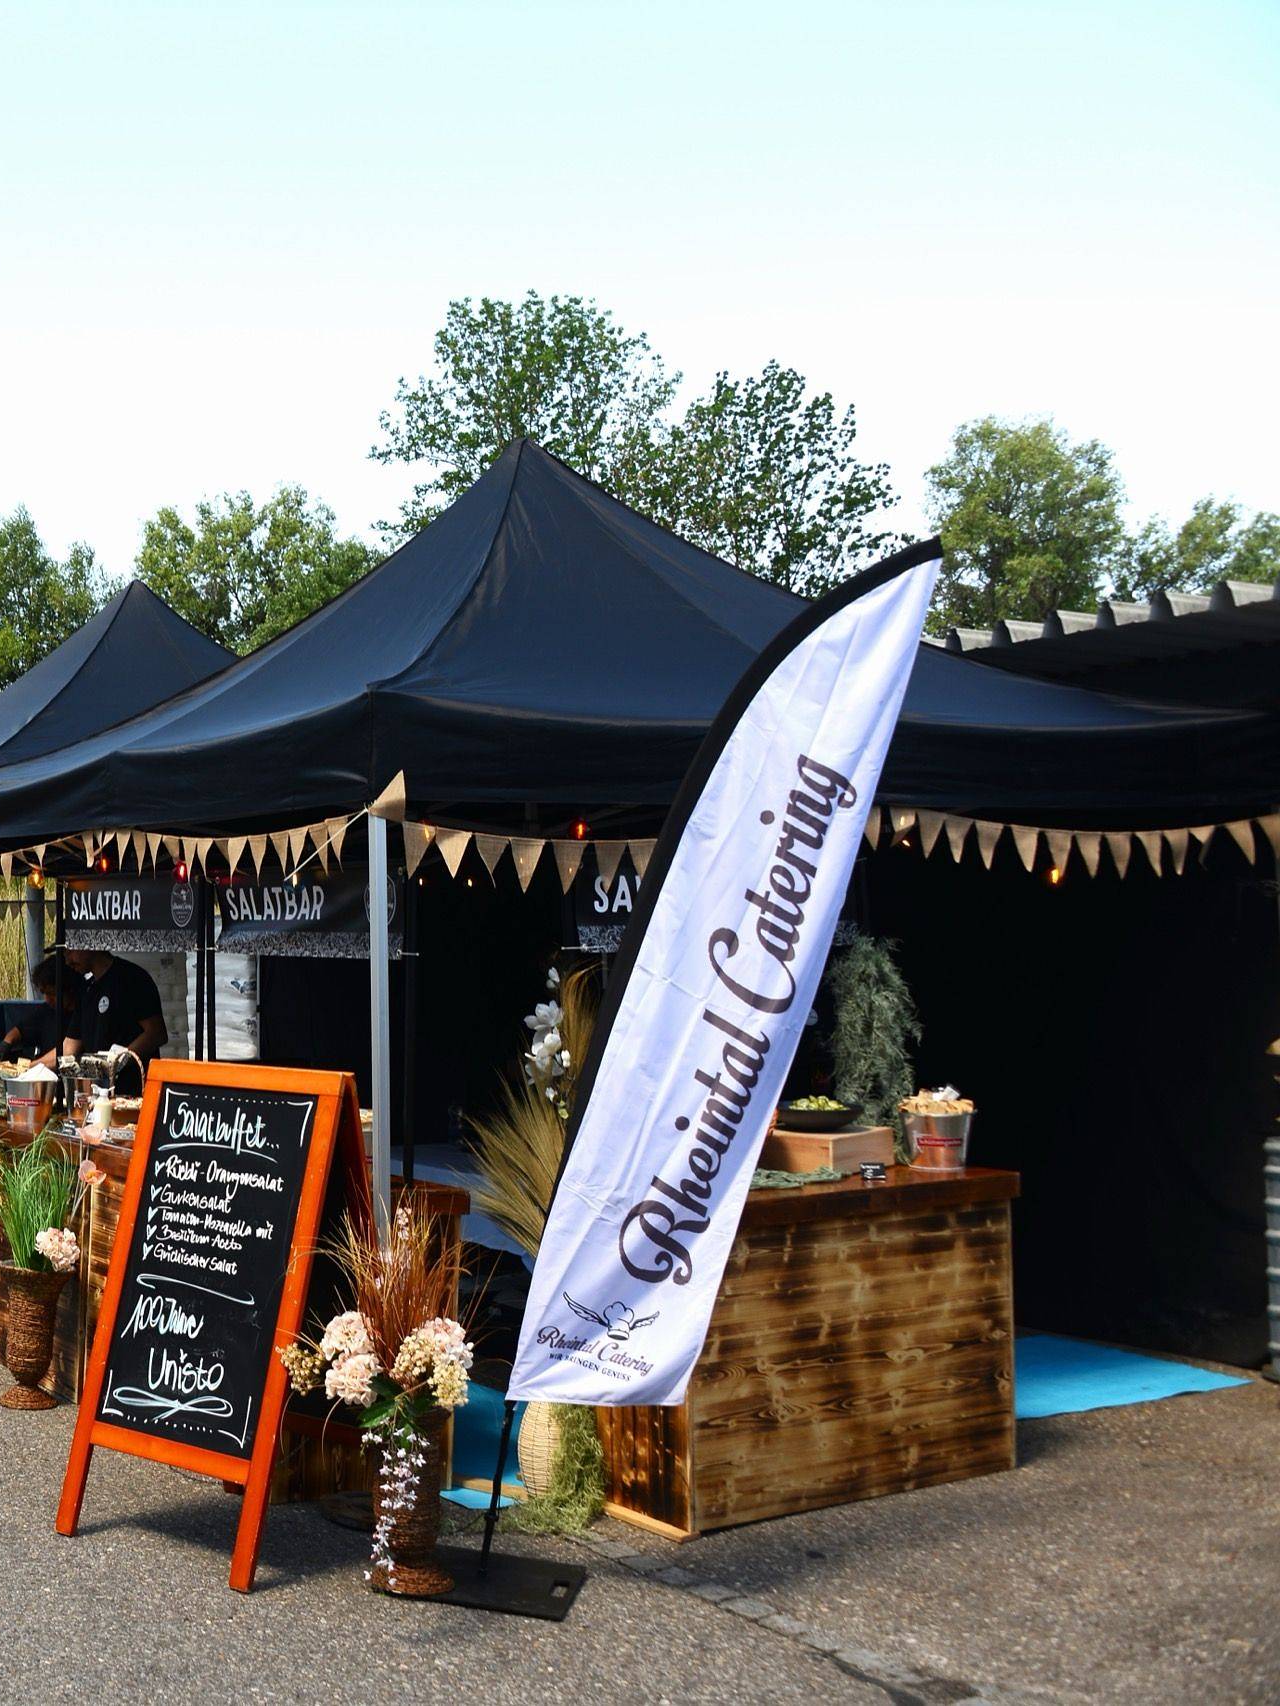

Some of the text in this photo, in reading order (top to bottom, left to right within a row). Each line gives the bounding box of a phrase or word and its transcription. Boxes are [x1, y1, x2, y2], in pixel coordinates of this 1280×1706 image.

[71, 889, 141, 921] SALATBAR
[225, 886, 325, 921] SALATBAR
[619, 753, 858, 1286] Rheintal Catering
[160, 1183, 231, 1213] Gurkensalat
[255, 1220, 273, 1240] mit
[209, 1257, 238, 1275] Salat
[121, 1294, 164, 1338] 100
[536, 1325, 654, 1377] Rheintal Catering
[549, 1353, 563, 1361] WIR
[601, 1367, 631, 1382] GENUSS
[148, 1347, 224, 1394] Unisto
